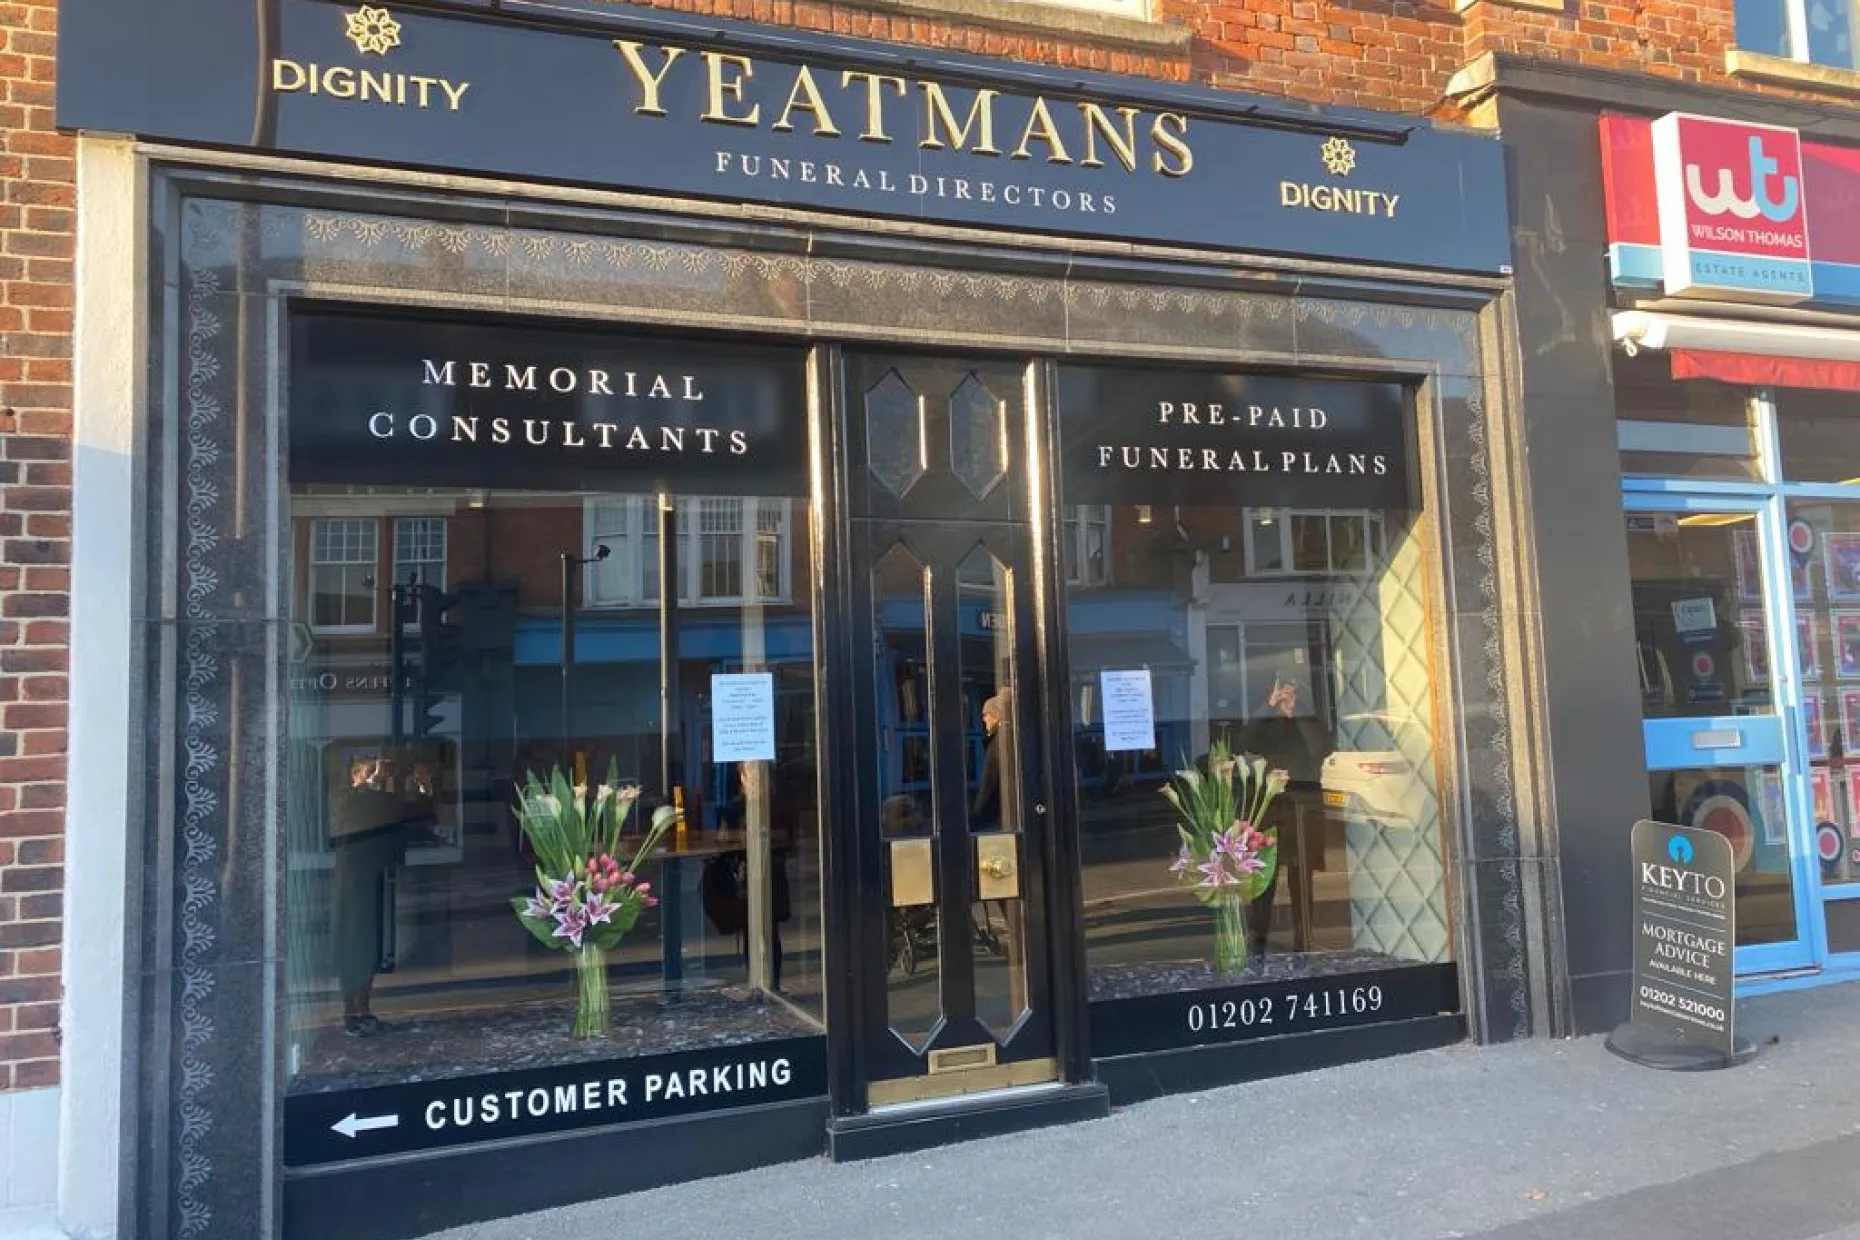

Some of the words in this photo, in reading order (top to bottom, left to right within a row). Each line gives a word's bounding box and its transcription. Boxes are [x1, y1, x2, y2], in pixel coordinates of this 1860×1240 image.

[272, 59, 471, 112] DIGNITY
[612, 40, 1194, 178] YEATMANS
[715, 152, 896, 192] FUNERAL
[909, 175, 1118, 215] DIRECTORS
[1280, 181, 1400, 219] DIGNITY
[1691, 224, 1745, 243] WILSON
[1747, 230, 1803, 248] THOMAS
[1695, 263, 1745, 277] ESTATE
[1753, 268, 1804, 282] AGENTS
[422, 359, 704, 401] MEMORIAL
[1158, 402, 1328, 428] PRE-PAID
[368, 413, 749, 455] CONSULTANTS
[1099, 446, 1270, 473] FUNERAL
[1282, 452, 1388, 475] PLANS
[1642, 920, 1727, 956] MORTGAGE
[1654, 941, 1710, 969] ADVICE
[1649, 958, 1692, 979] AVAILABLE
[1694, 971, 1716, 986] HERE
[1187, 998, 1273, 1032] 01202
[1285, 985, 1383, 1022] 741169
[1640, 985, 1676, 1007] 01202
[1677, 996, 1725, 1022] 521000
[425, 1076, 629, 1130] CUSTOMER
[645, 1057, 792, 1102] PARKING
